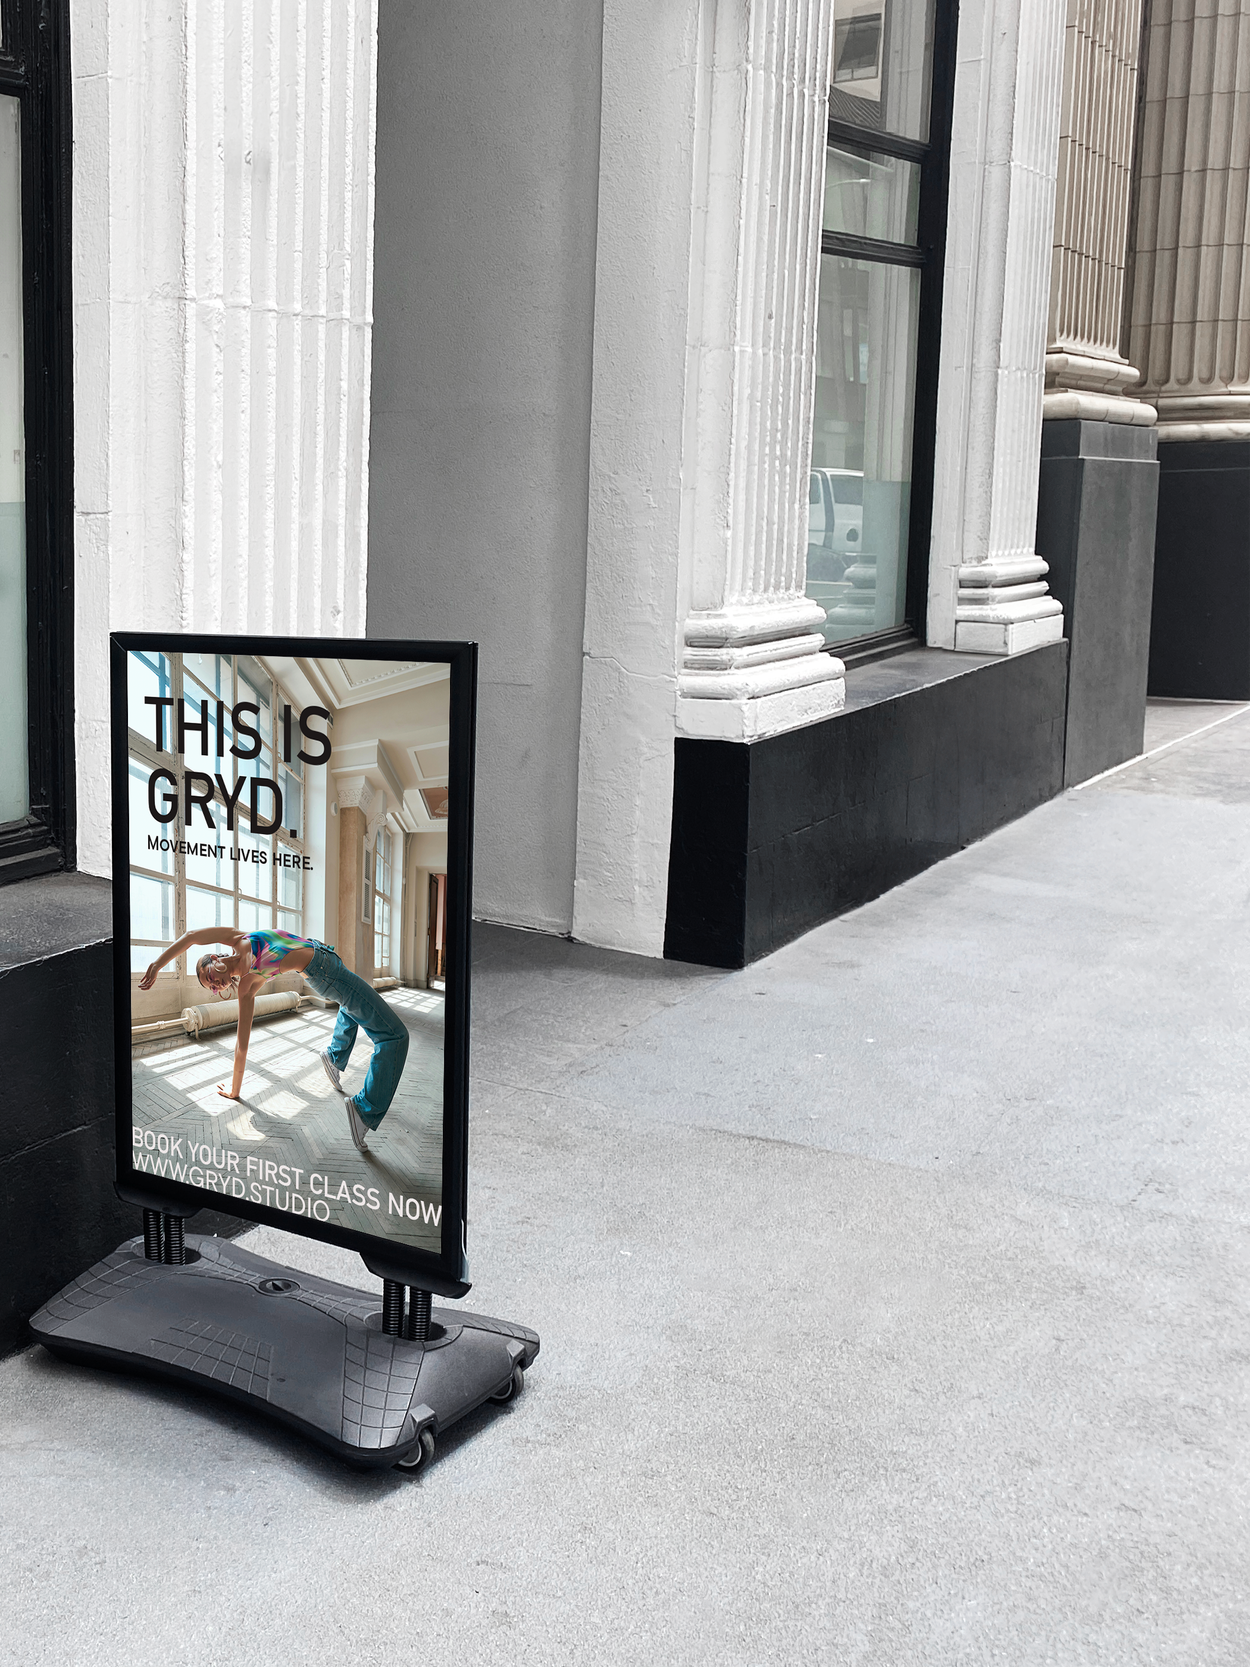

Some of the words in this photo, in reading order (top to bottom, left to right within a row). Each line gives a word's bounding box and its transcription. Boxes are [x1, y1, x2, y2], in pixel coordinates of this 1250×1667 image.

[144, 695, 263, 761] THIS
[282, 703, 333, 766] IS
[147, 767, 298, 839] GRYD.
[147, 834, 226, 859] MOVEMENT
[229, 846, 268, 865] LIVES
[272, 852, 314, 871] HERE.
[132, 1125, 184, 1159] BOOK
[187, 1140, 240, 1174] YOUR
[246, 1155, 304, 1190] FIRST
[309, 1173, 381, 1211] CLASS
[388, 1192, 443, 1227] NOW
[132, 1150, 331, 1222] WWW.GRYD.STUDIO
